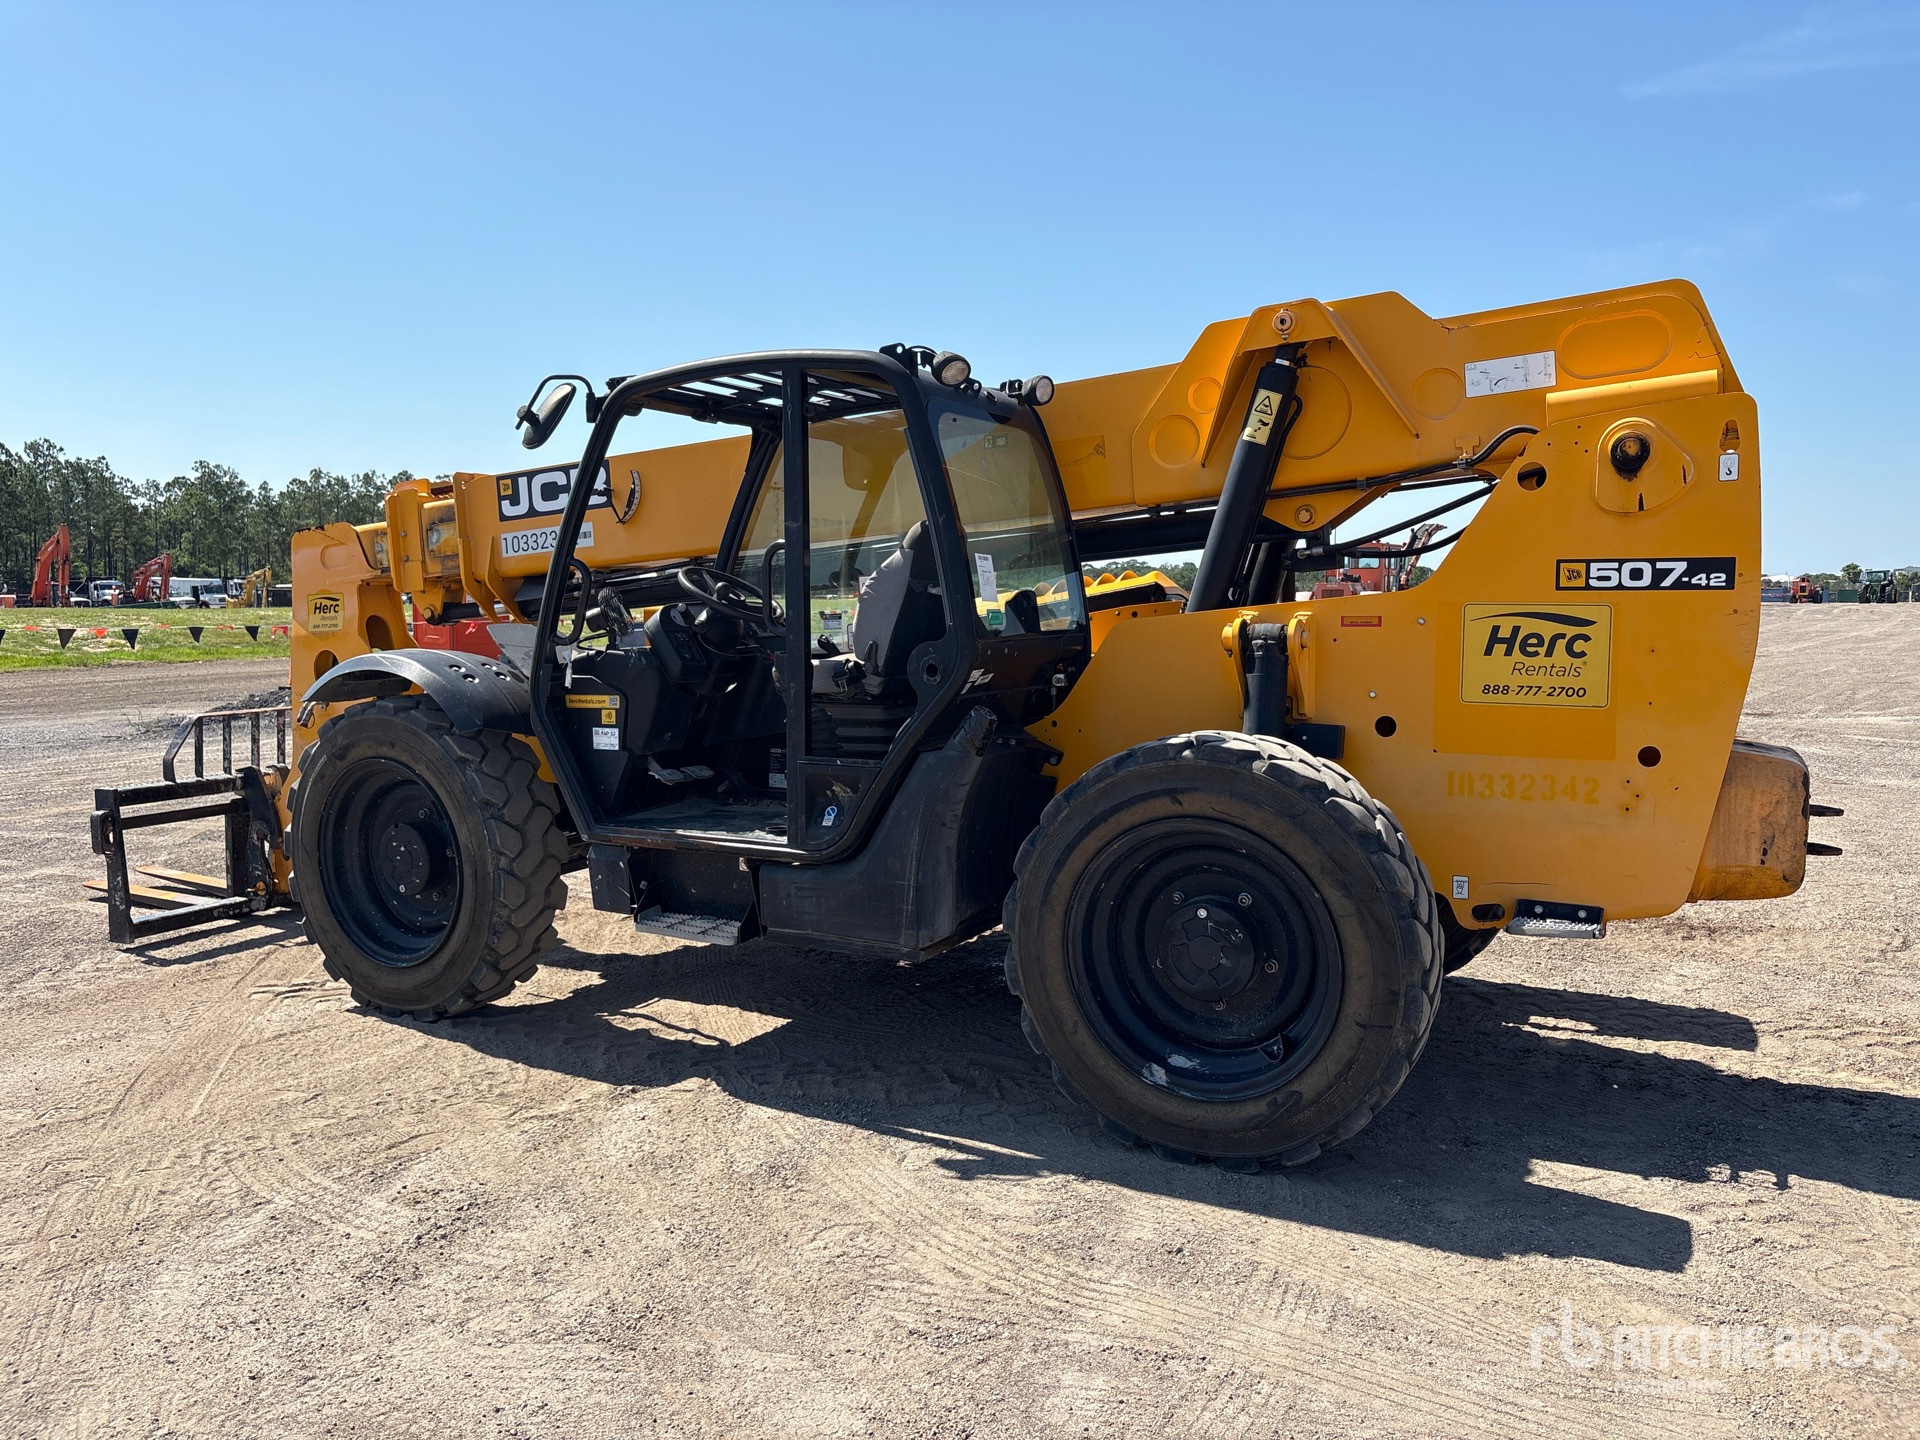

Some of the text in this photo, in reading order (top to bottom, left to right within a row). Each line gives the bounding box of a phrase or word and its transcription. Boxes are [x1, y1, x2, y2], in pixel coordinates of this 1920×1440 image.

[503, 530, 578, 555] 103323
[1566, 561, 1727, 588] JCB 507-42
[314, 602, 340, 615] Herc
[1483, 624, 1592, 659] Herc
[1511, 661, 1582, 678] Rentals
[1481, 684, 1587, 698] 888-777-2700
[1447, 770, 1600, 804] 10332342
